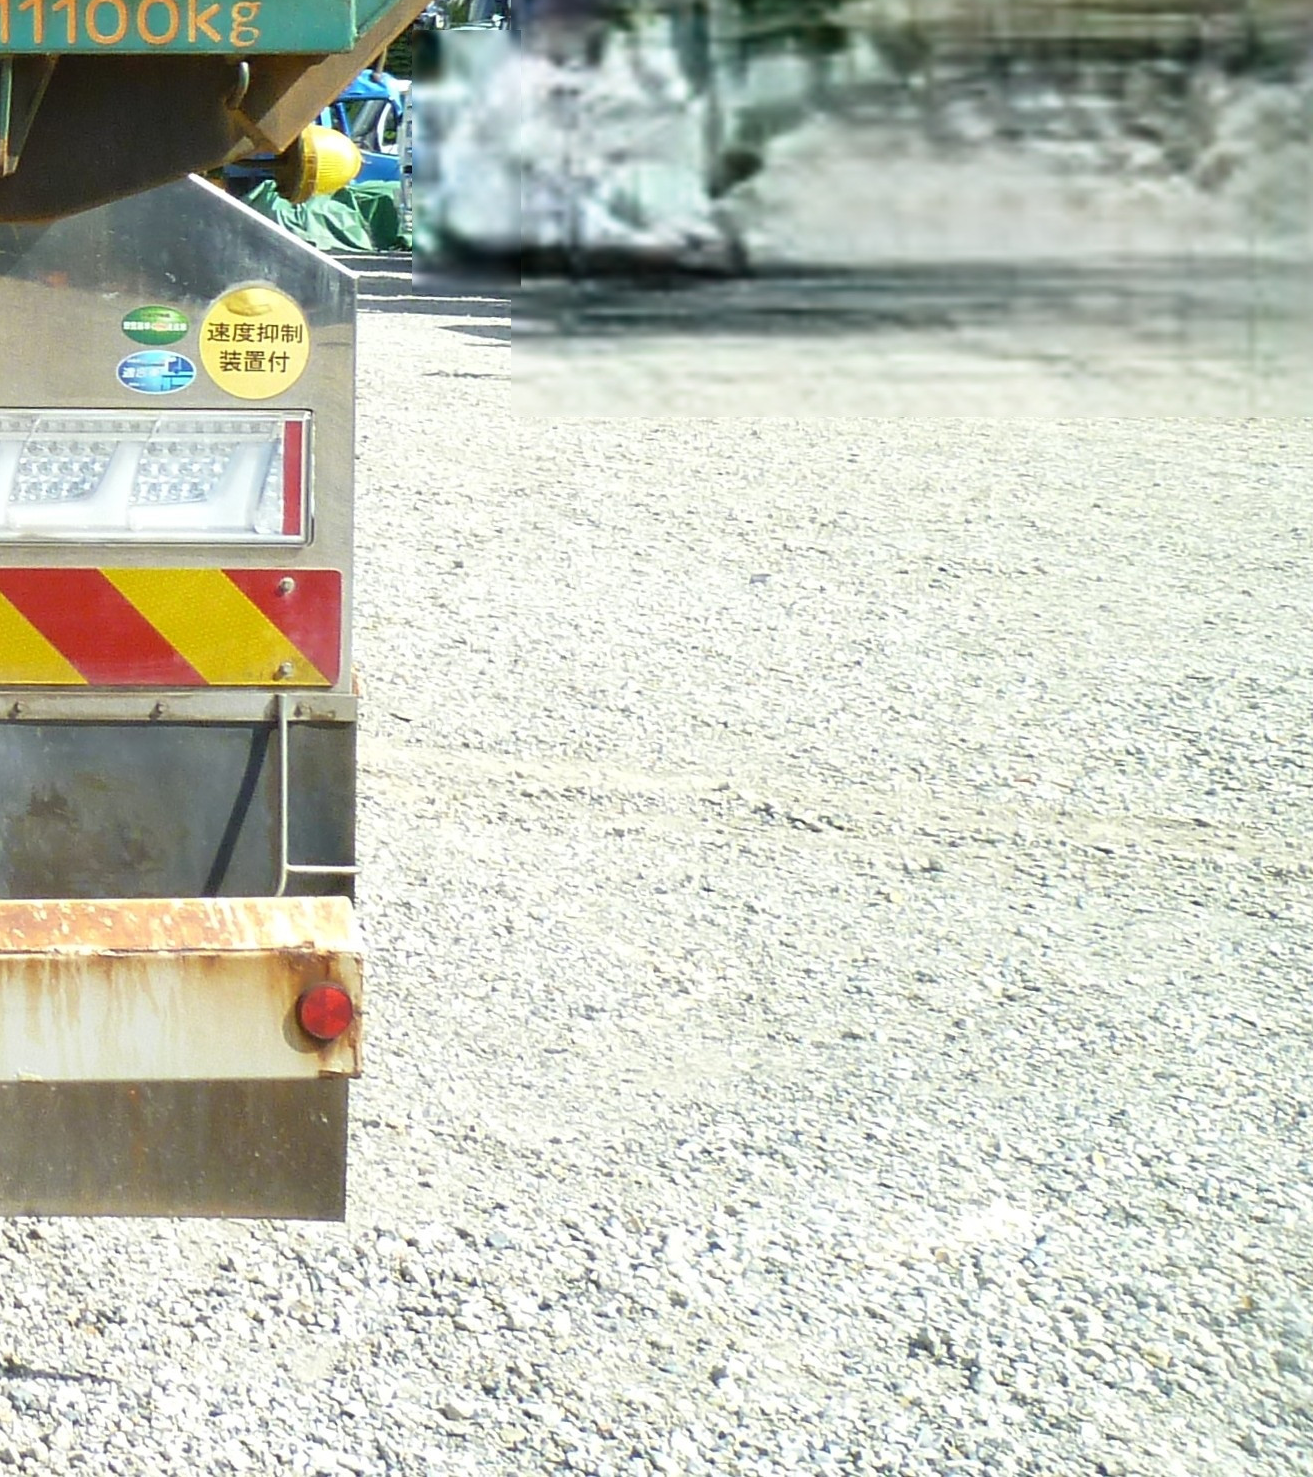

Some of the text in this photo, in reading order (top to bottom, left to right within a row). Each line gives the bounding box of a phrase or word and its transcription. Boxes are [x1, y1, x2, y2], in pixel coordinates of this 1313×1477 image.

[207, 322, 304, 344] 速度抑制
[219, 350, 290, 373] 装置付
